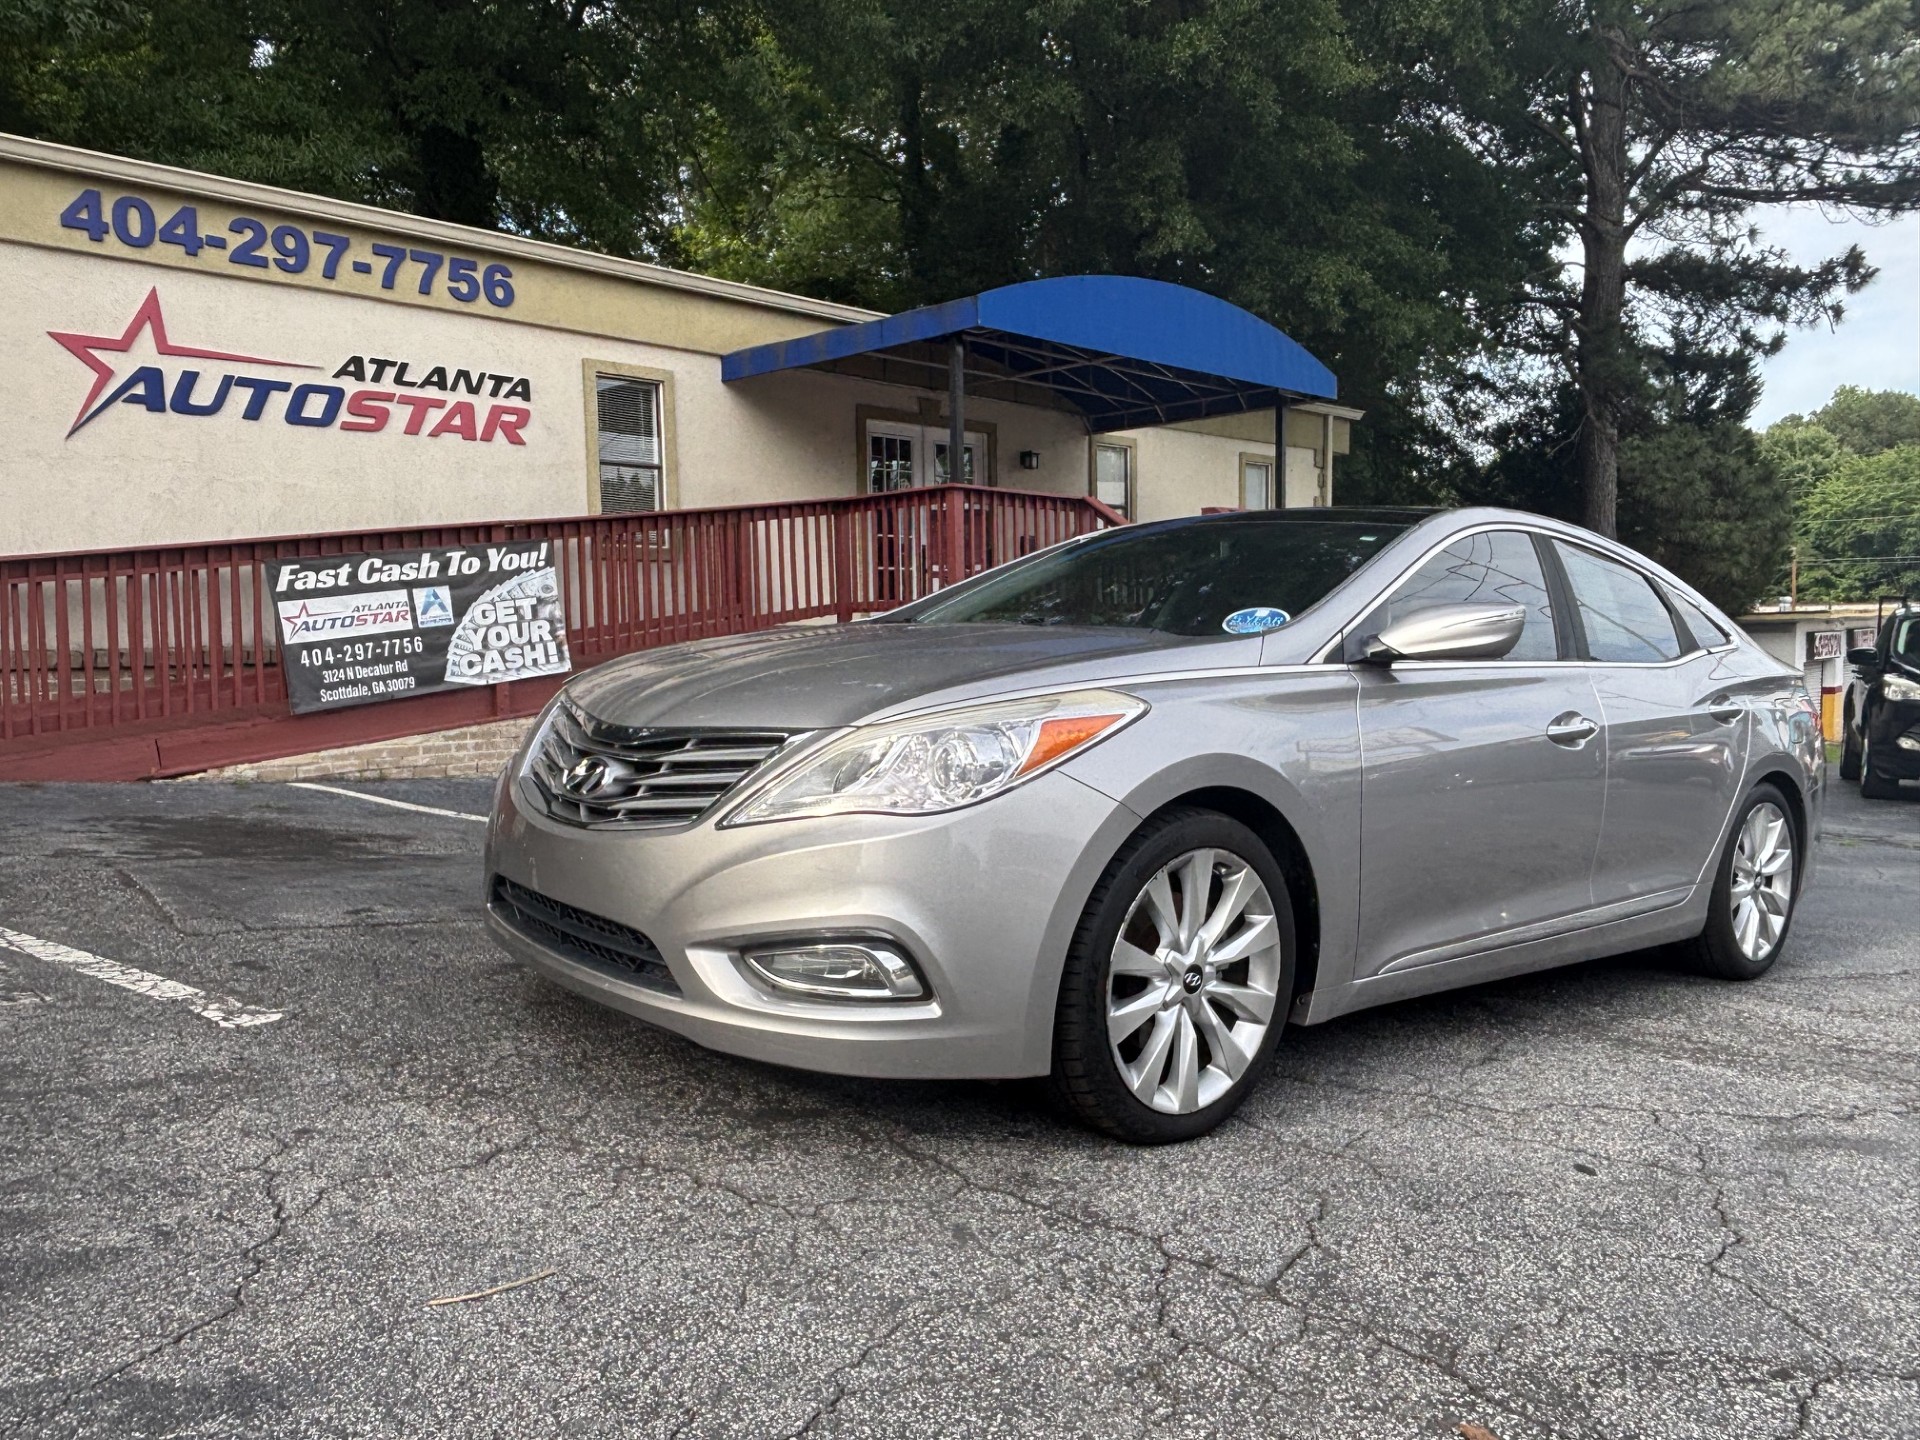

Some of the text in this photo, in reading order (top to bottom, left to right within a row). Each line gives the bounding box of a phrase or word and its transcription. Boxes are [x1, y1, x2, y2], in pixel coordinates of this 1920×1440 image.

[60, 189, 516, 308] 404-297-7756
[332, 354, 532, 402] ATLANTA
[66, 365, 532, 445] AUTOSTAR
[275, 542, 548, 592] Fast Cash To You!
[351, 600, 410, 614] ATLANTA
[472, 597, 537, 627] GET
[466, 619, 552, 651] YOUR
[301, 636, 423, 668] 404-297-7756
[458, 641, 559, 676] CASH!
[323, 660, 408, 684] 3124 N Decatur Rd
[320, 676, 415, 702] Scottdale, GA 30079
